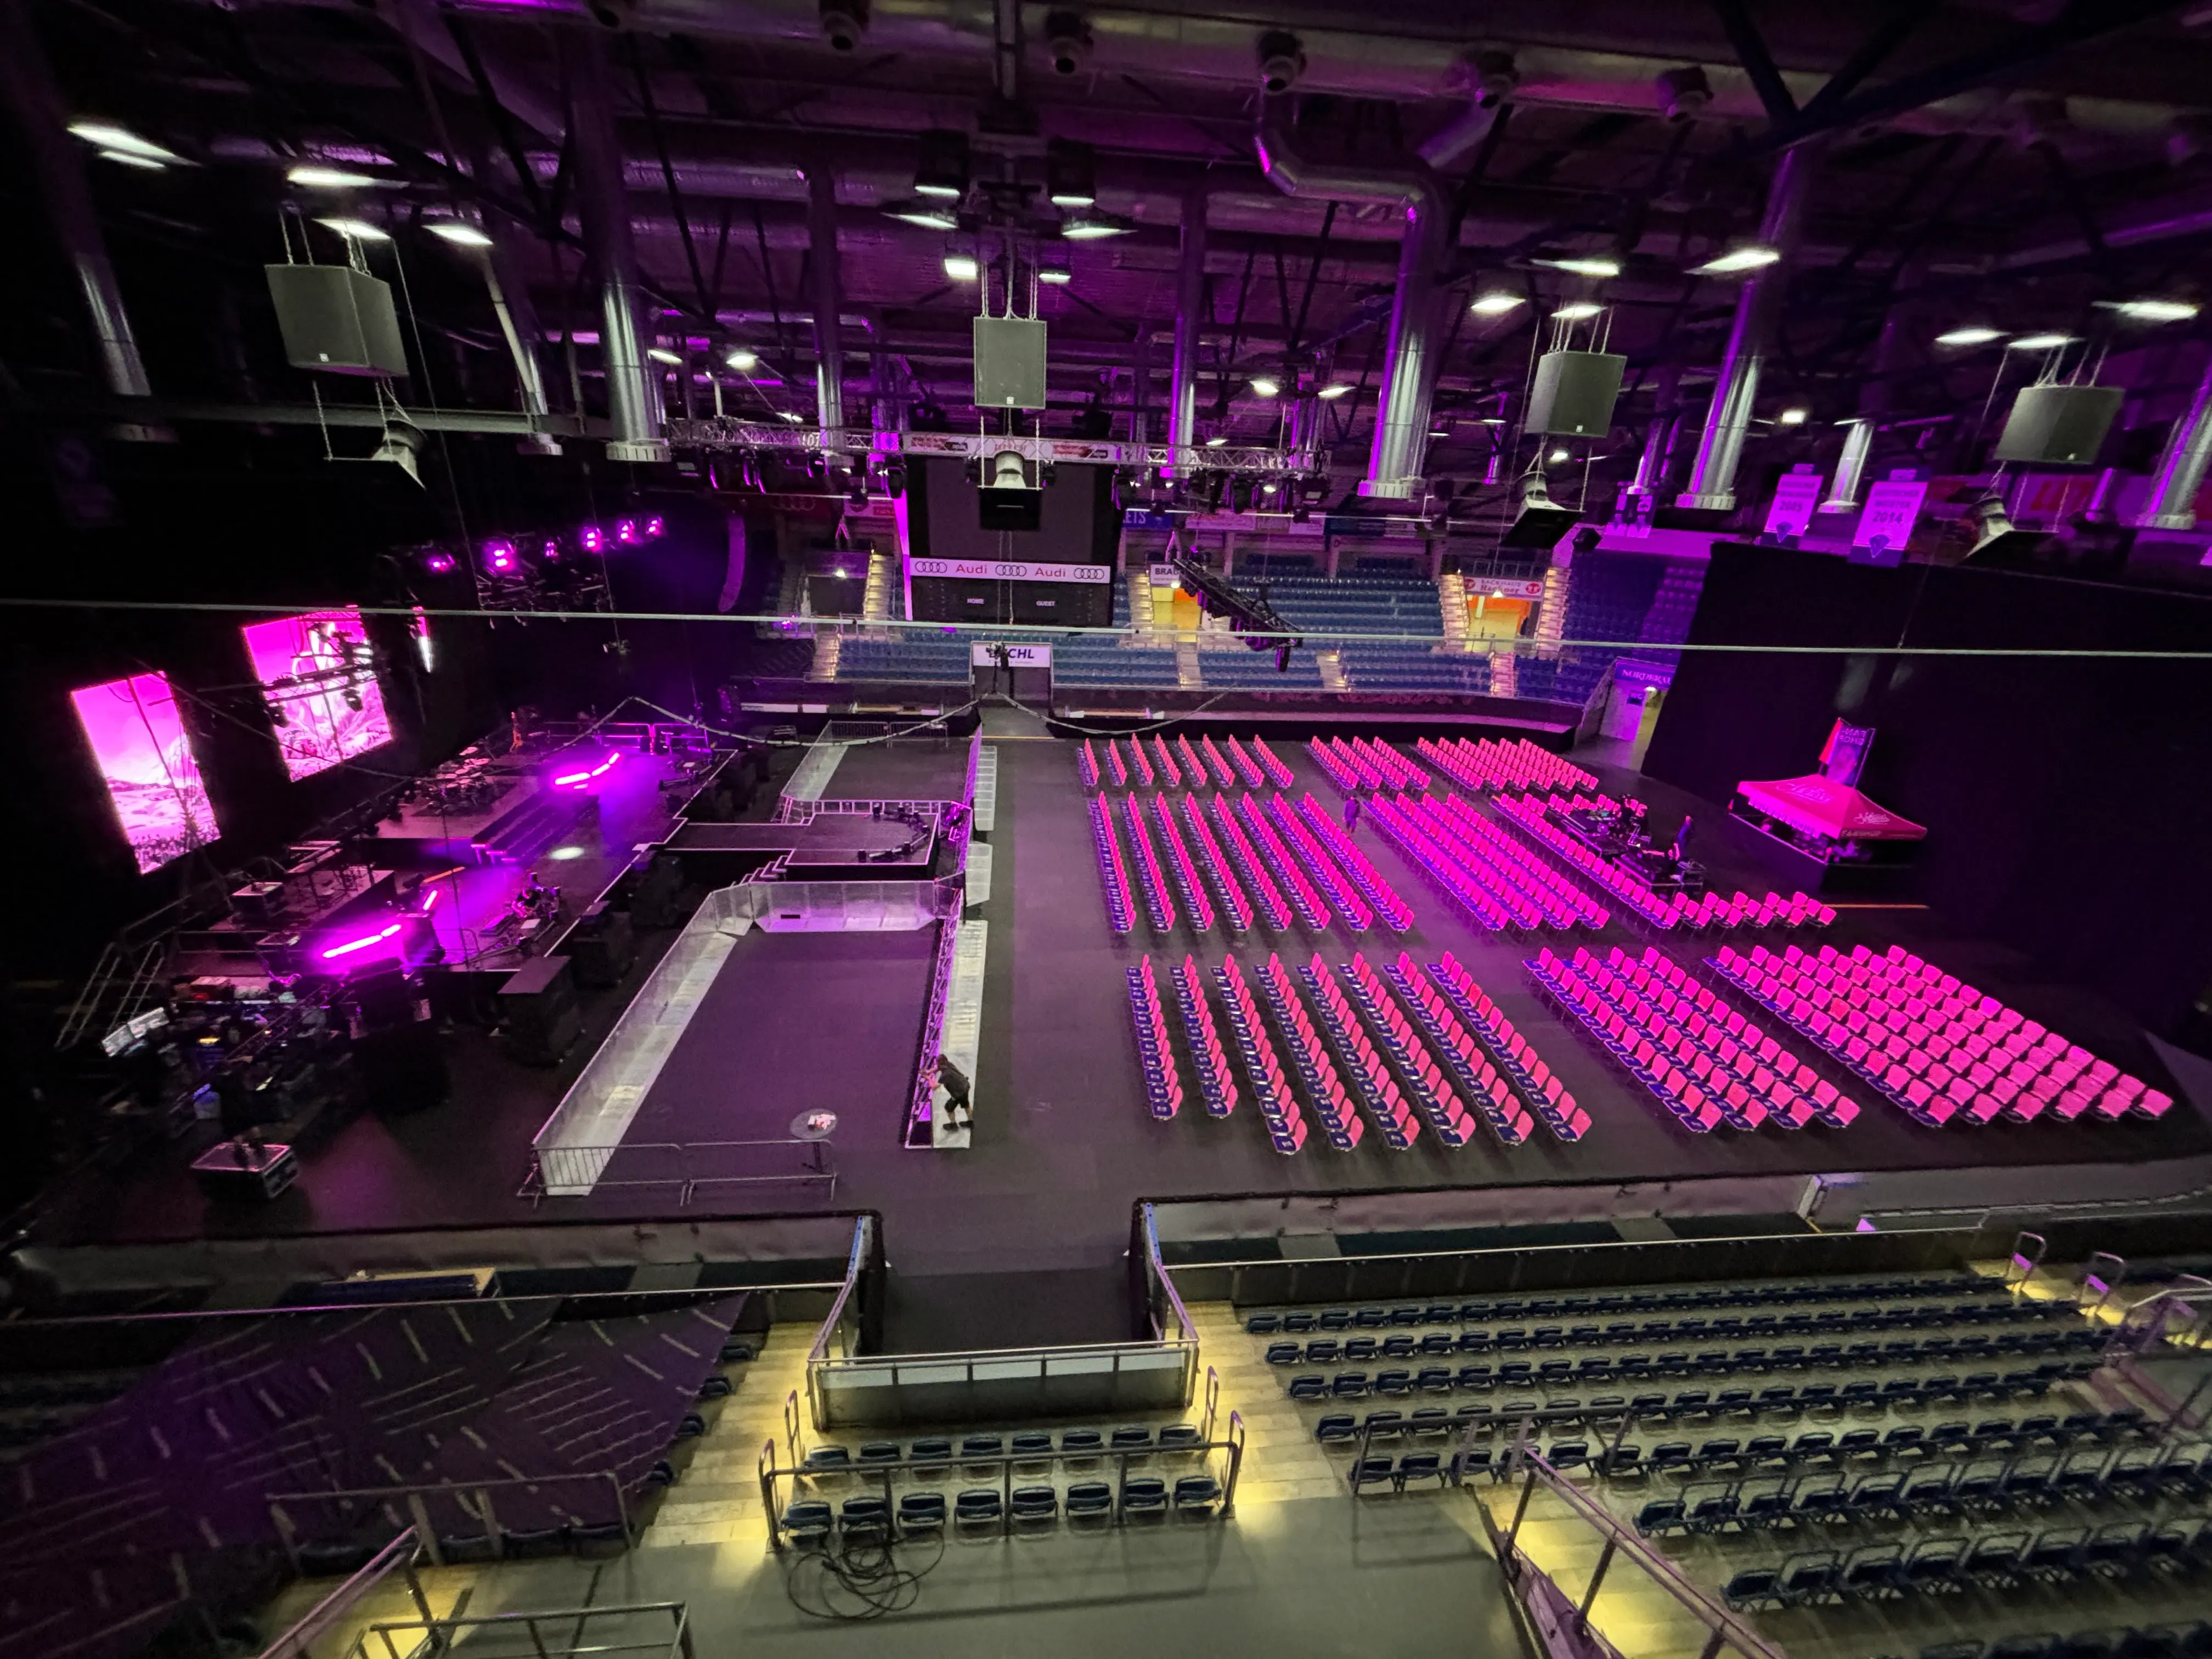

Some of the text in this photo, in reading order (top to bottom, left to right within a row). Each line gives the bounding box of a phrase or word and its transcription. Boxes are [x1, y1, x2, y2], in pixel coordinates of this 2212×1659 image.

[1872, 511, 1904, 523] 2014
[956, 564, 1065, 578] Audi Audi
